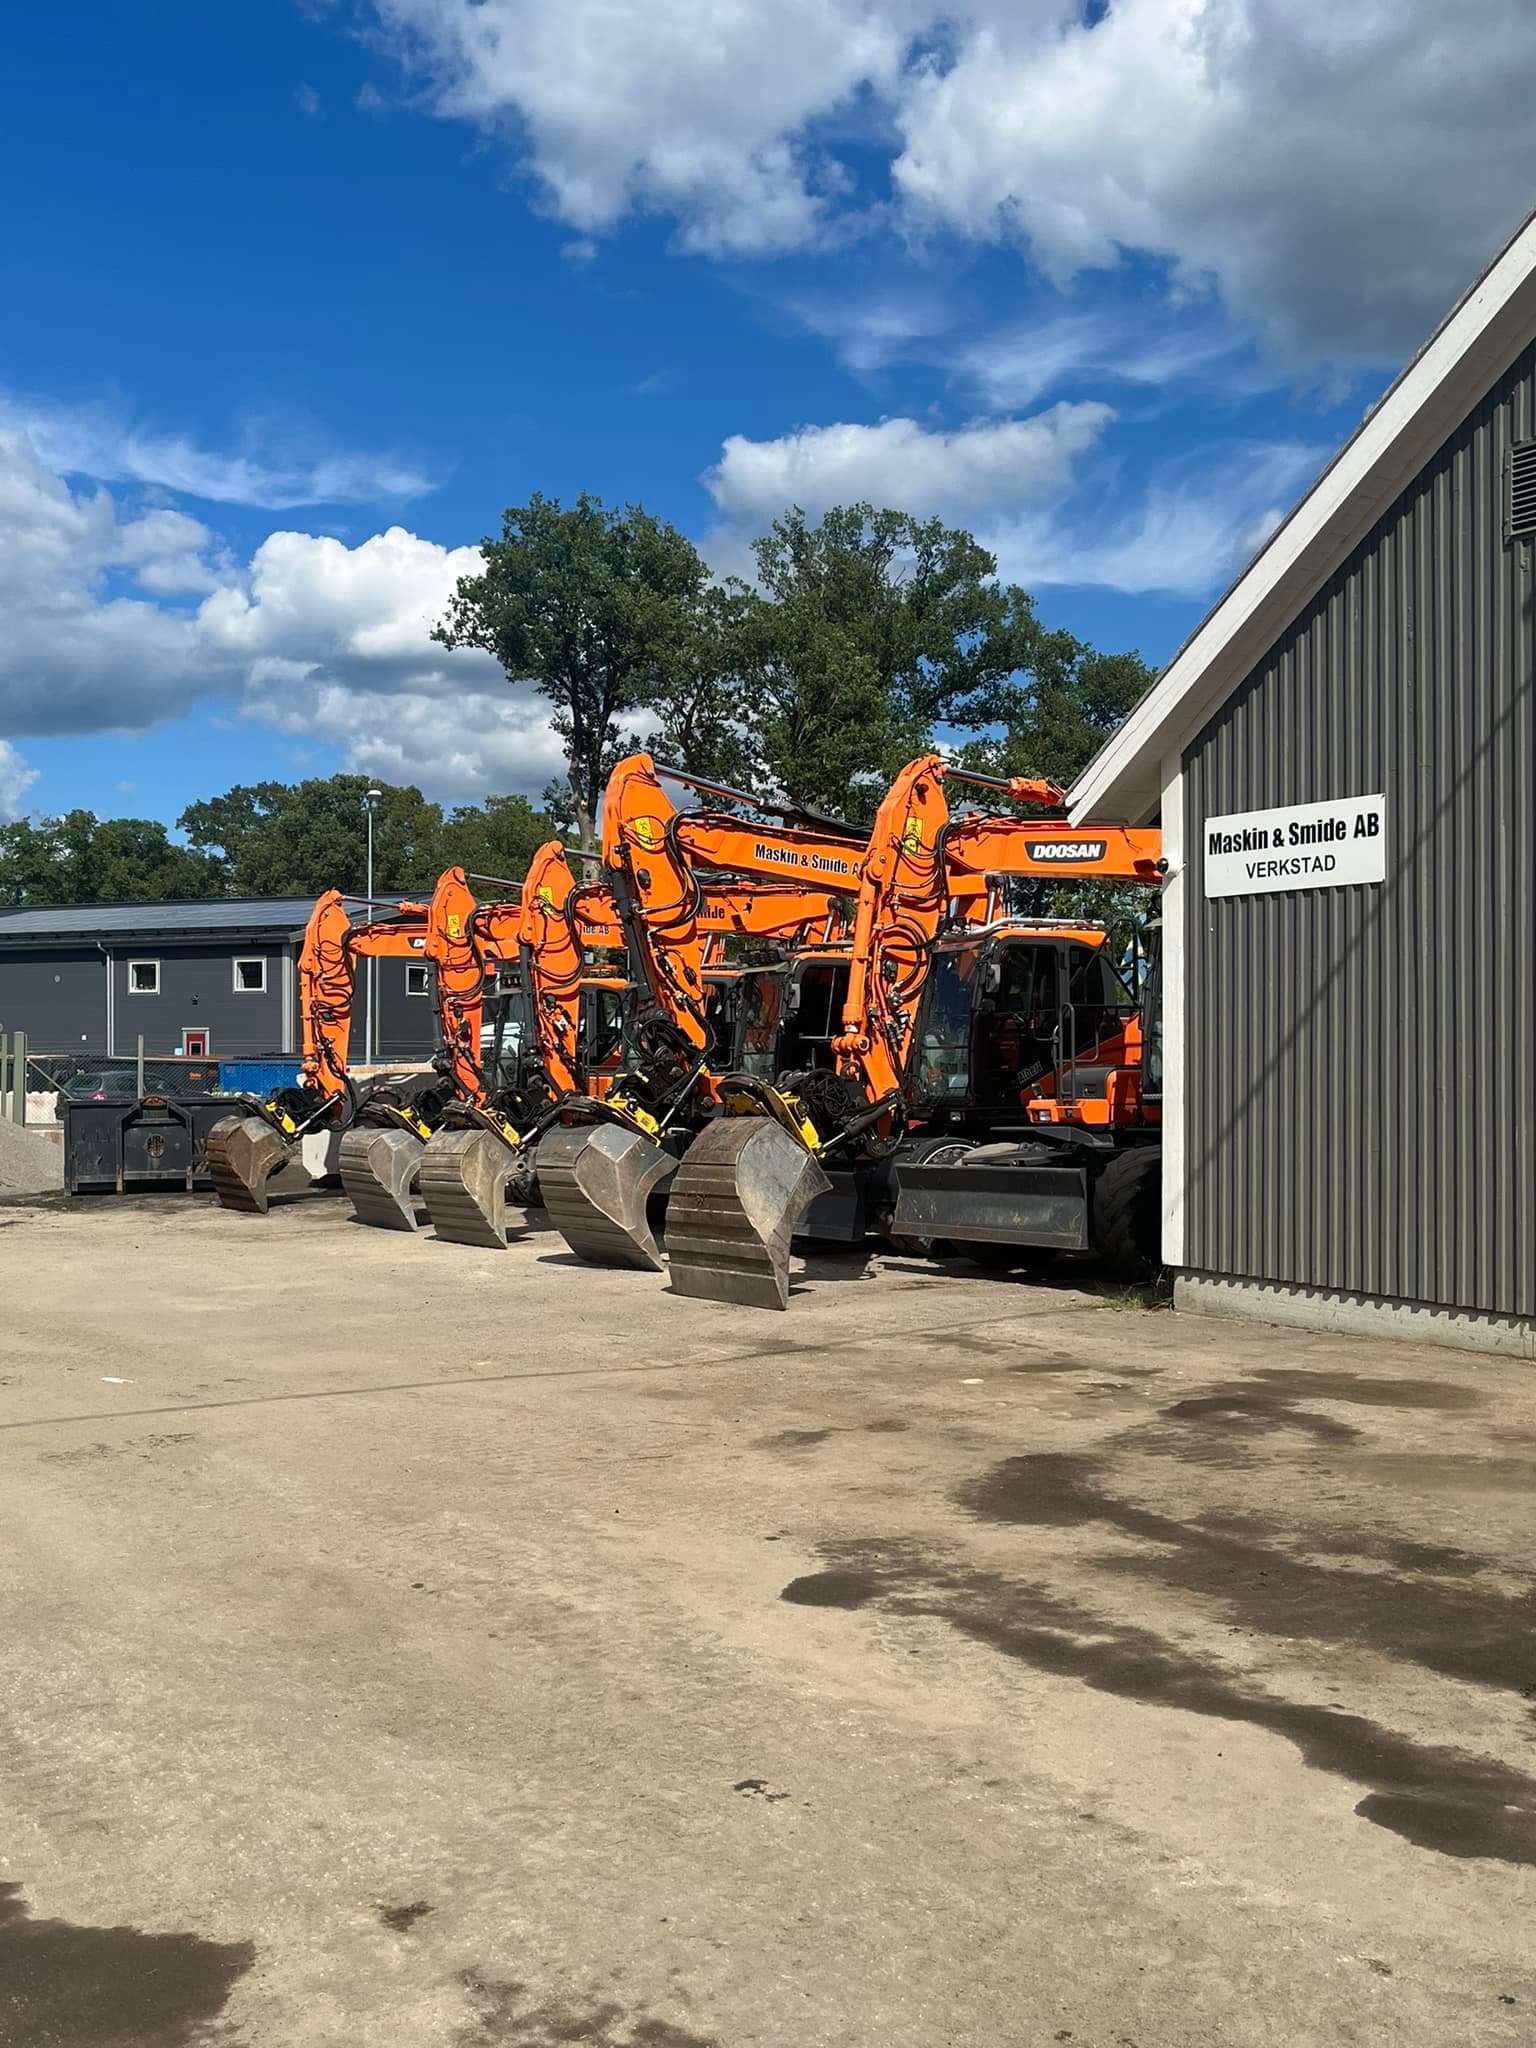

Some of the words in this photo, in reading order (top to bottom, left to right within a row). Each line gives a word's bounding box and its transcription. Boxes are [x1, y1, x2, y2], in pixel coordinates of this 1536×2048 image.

[1208, 827, 1268, 856] Maskin
[1272, 828, 1285, 848] &
[1288, 818, 1347, 846] Smide
[1353, 812, 1380, 839] AB
[755, 843, 798, 865] Maskin
[800, 854, 809, 867] &
[812, 854, 848, 874] Smide
[1033, 844, 1101, 859] DOOSAN
[1245, 854, 1336, 879] VERKSTAD
[696, 905, 726, 920] ide
